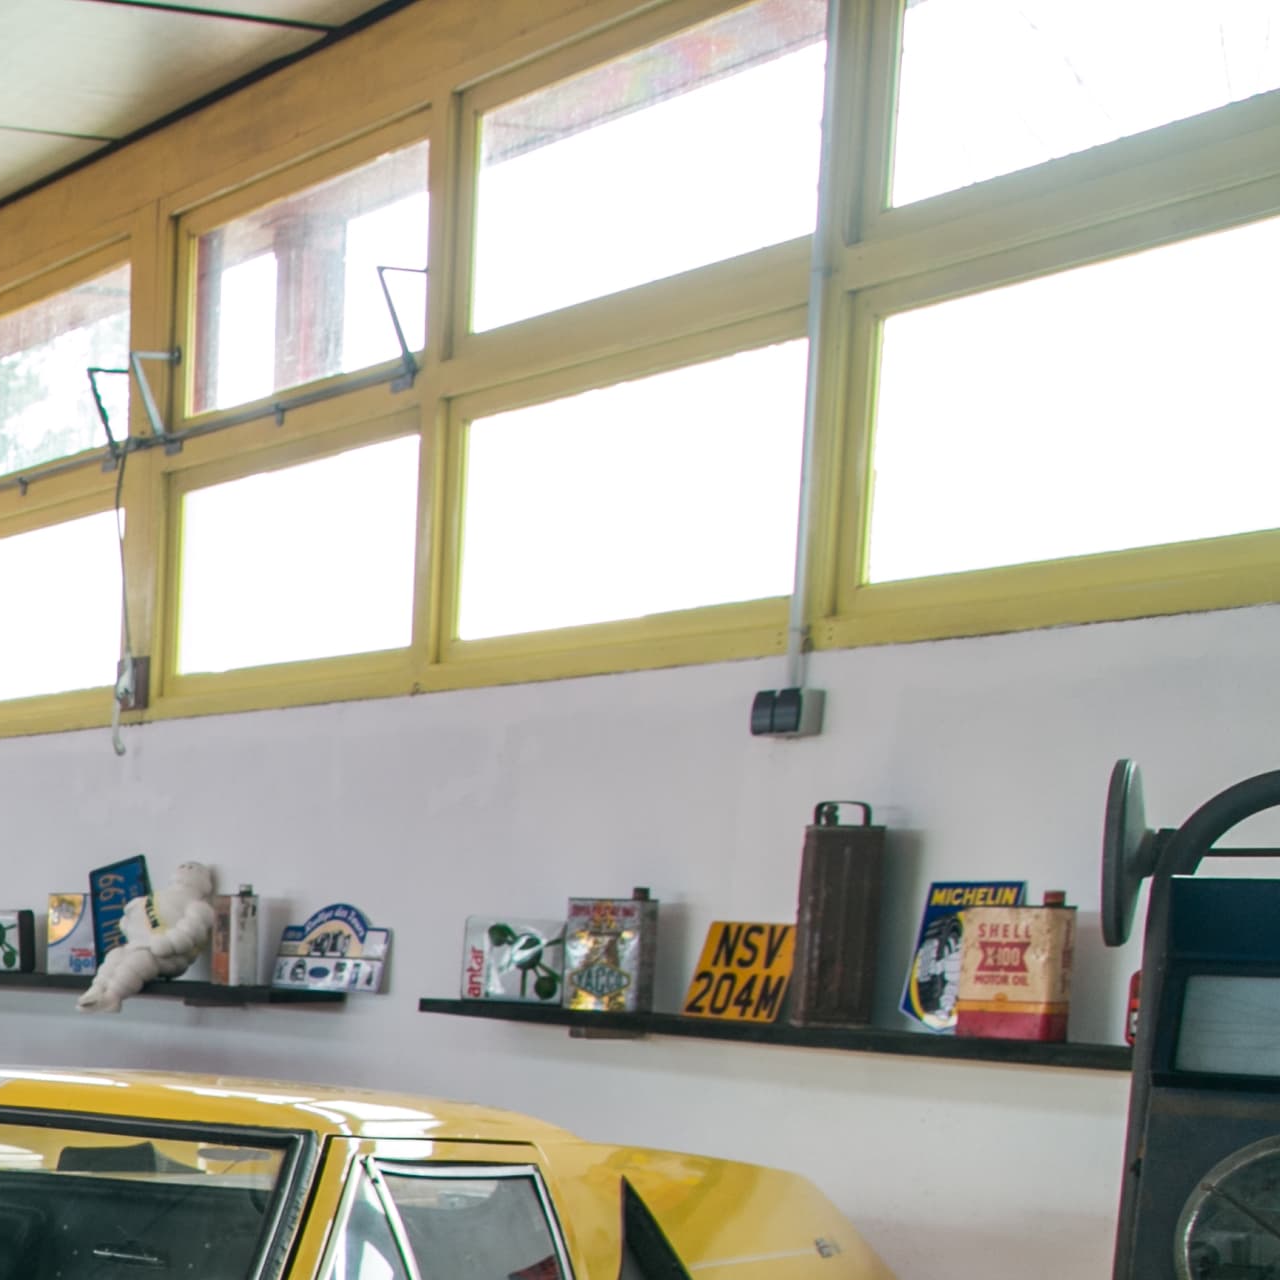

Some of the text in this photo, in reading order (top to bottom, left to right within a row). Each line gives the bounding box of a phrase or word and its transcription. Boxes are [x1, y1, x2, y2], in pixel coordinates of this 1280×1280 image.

[930, 886, 1018, 906] MICHELIN
[978, 923, 1032, 938] SHELL
[711, 924, 790, 969] NSV
[985, 947, 1021, 967] X-100
[467, 944, 484, 998] antar
[973, 974, 1029, 986] MOTOR OIL
[684, 970, 785, 1019] 204M
